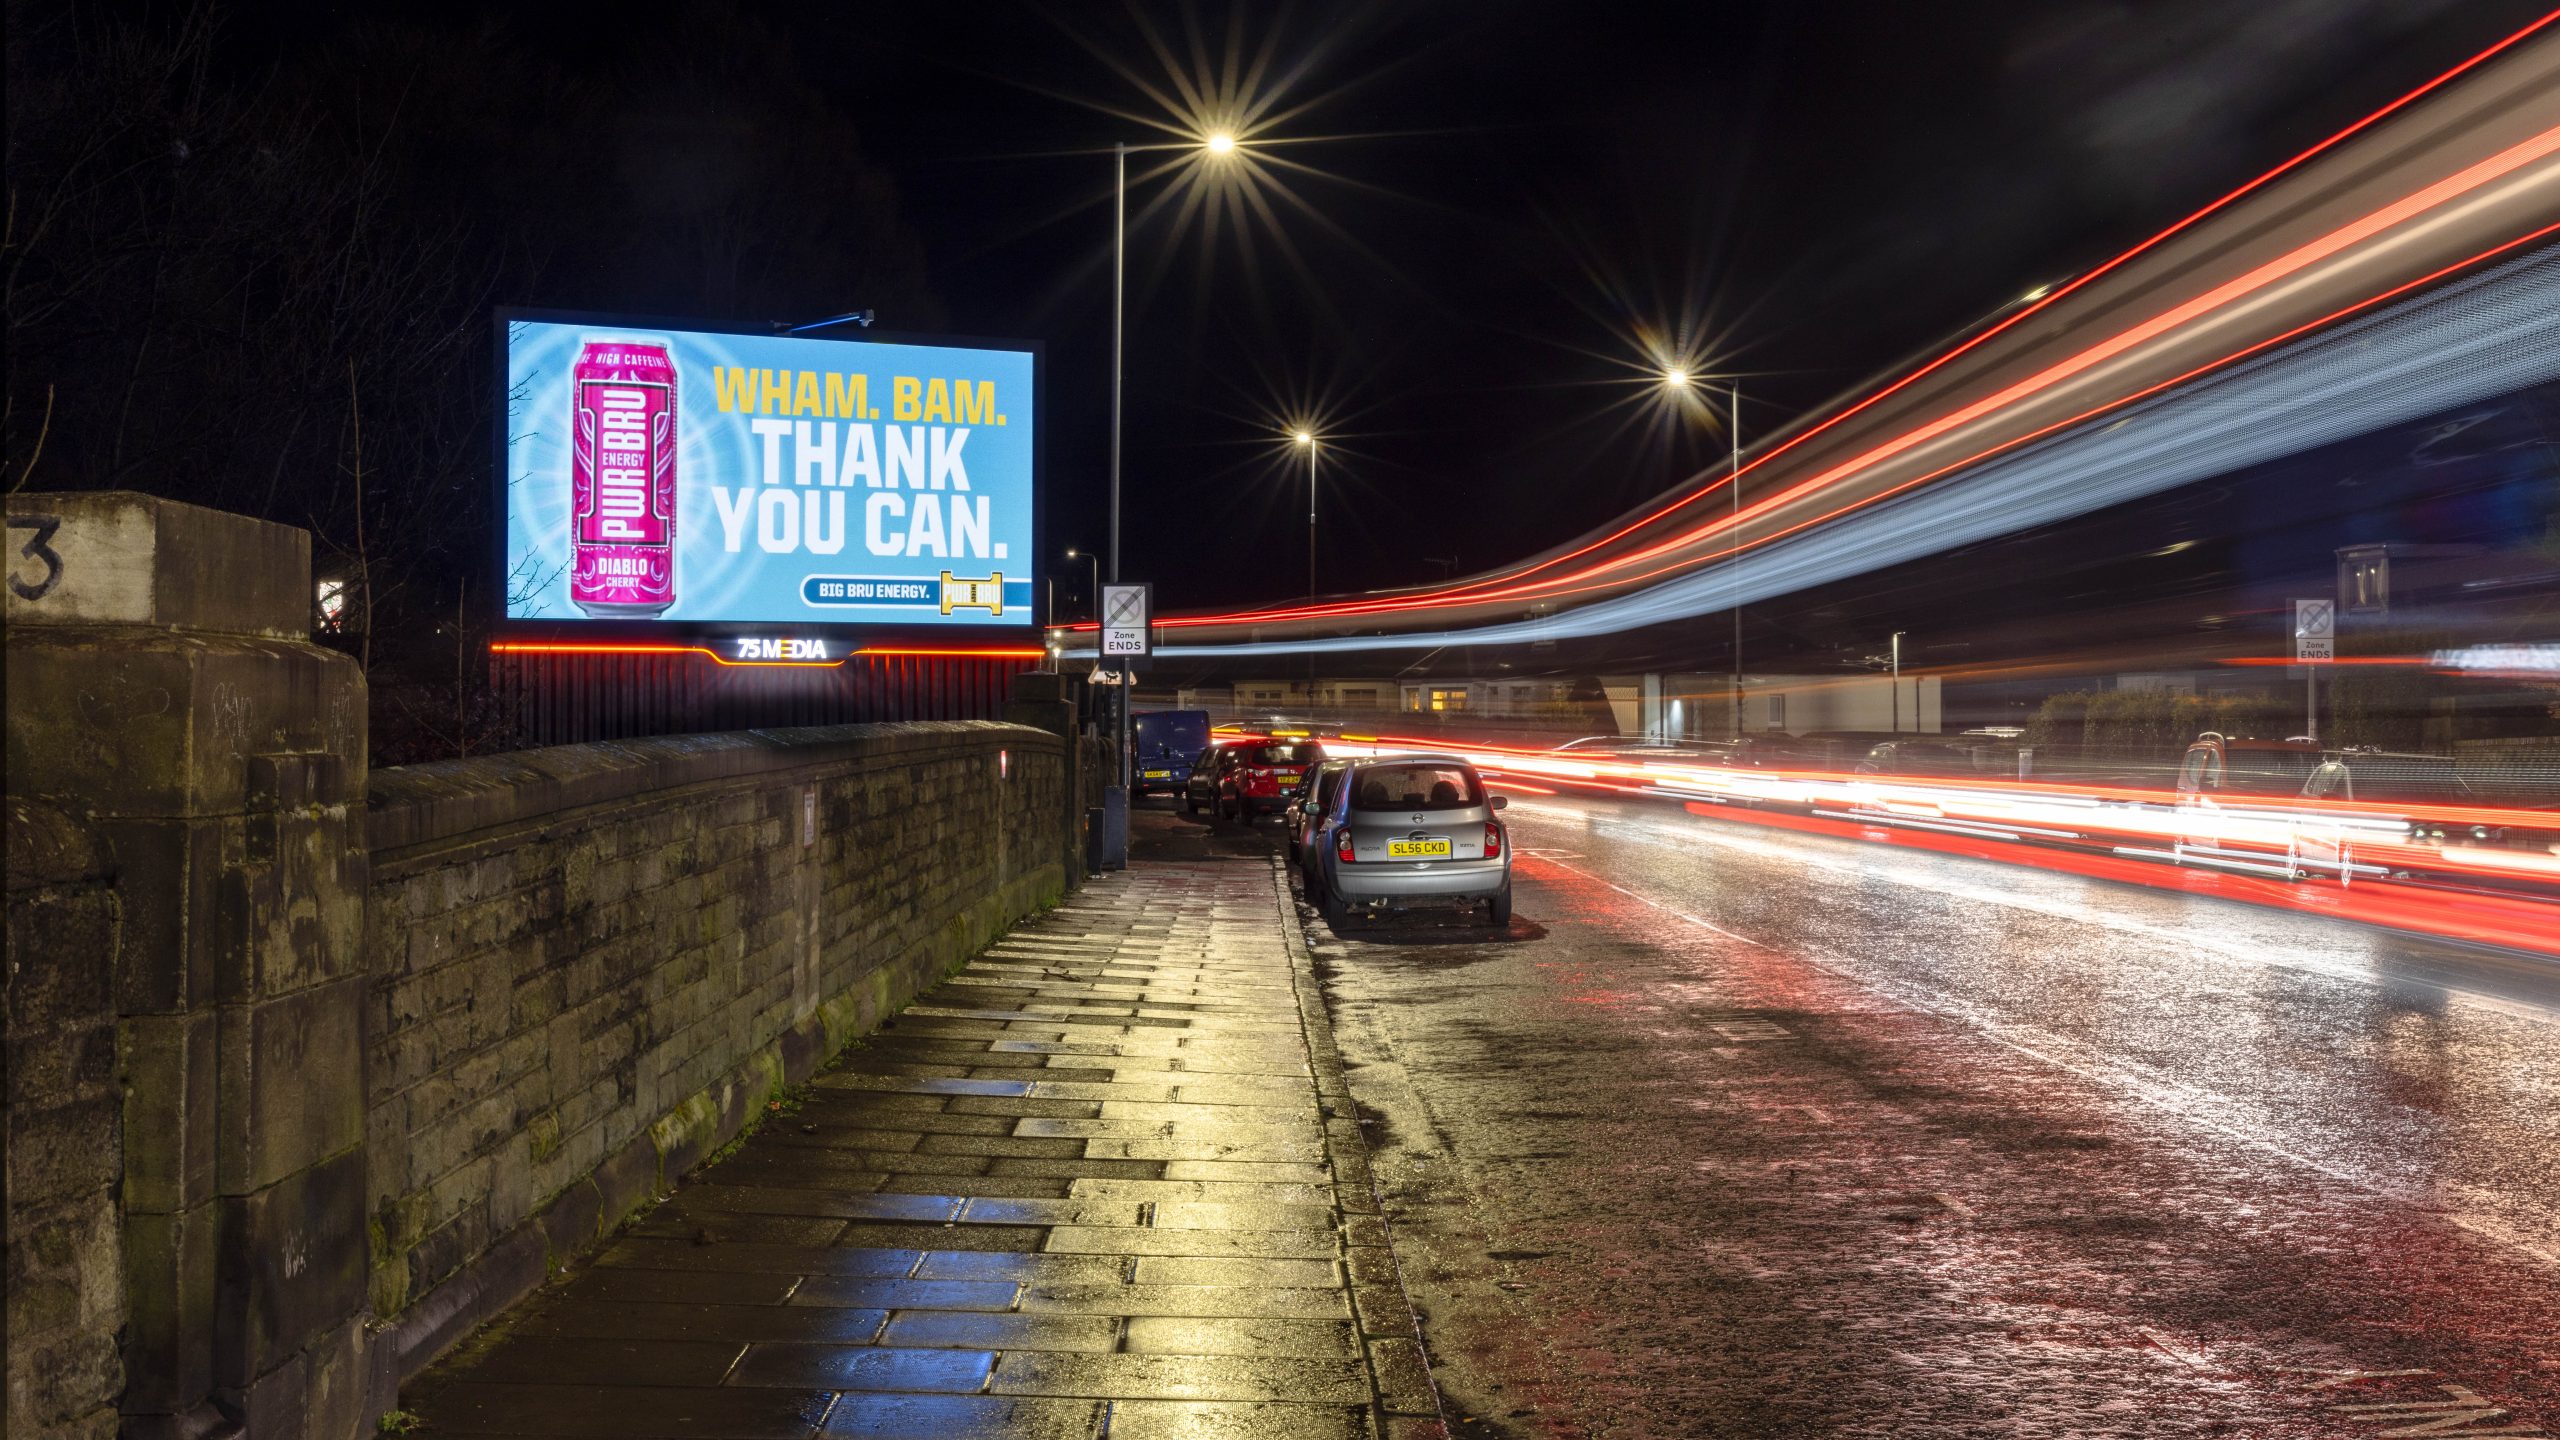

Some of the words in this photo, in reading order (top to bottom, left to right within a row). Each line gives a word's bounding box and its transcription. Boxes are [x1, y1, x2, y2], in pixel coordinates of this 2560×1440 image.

[596, 353, 620, 365] HIGH
[624, 352, 667, 368] CAFFEINE
[714, 367, 879, 420] WHAM.
[893, 377, 1006, 425] BAM.
[603, 390, 646, 450] BRU
[603, 453, 645, 467] ENERGY
[752, 419, 970, 491] THANK
[602, 469, 645, 538] PWR
[712, 487, 845, 554] YOU
[866, 493, 1008, 559] CAN.
[598, 558, 648, 576] DIABLO
[606, 577, 640, 588] CHERRY
[819, 583, 844, 598] BIG
[847, 584, 874, 598] BRU
[876, 585, 931, 600] ENERGY.
[1114, 631, 1136, 640] Zone
[737, 638, 761, 659] 75
[762, 639, 828, 660] MEDIA
[1109, 642, 1142, 651] ENDS
[2305, 641, 2325, 649] Zone
[2301, 650, 2331, 659] ENDS
[1394, 843, 1422, 854] SL56
[1424, 842, 1446, 853] CKD
